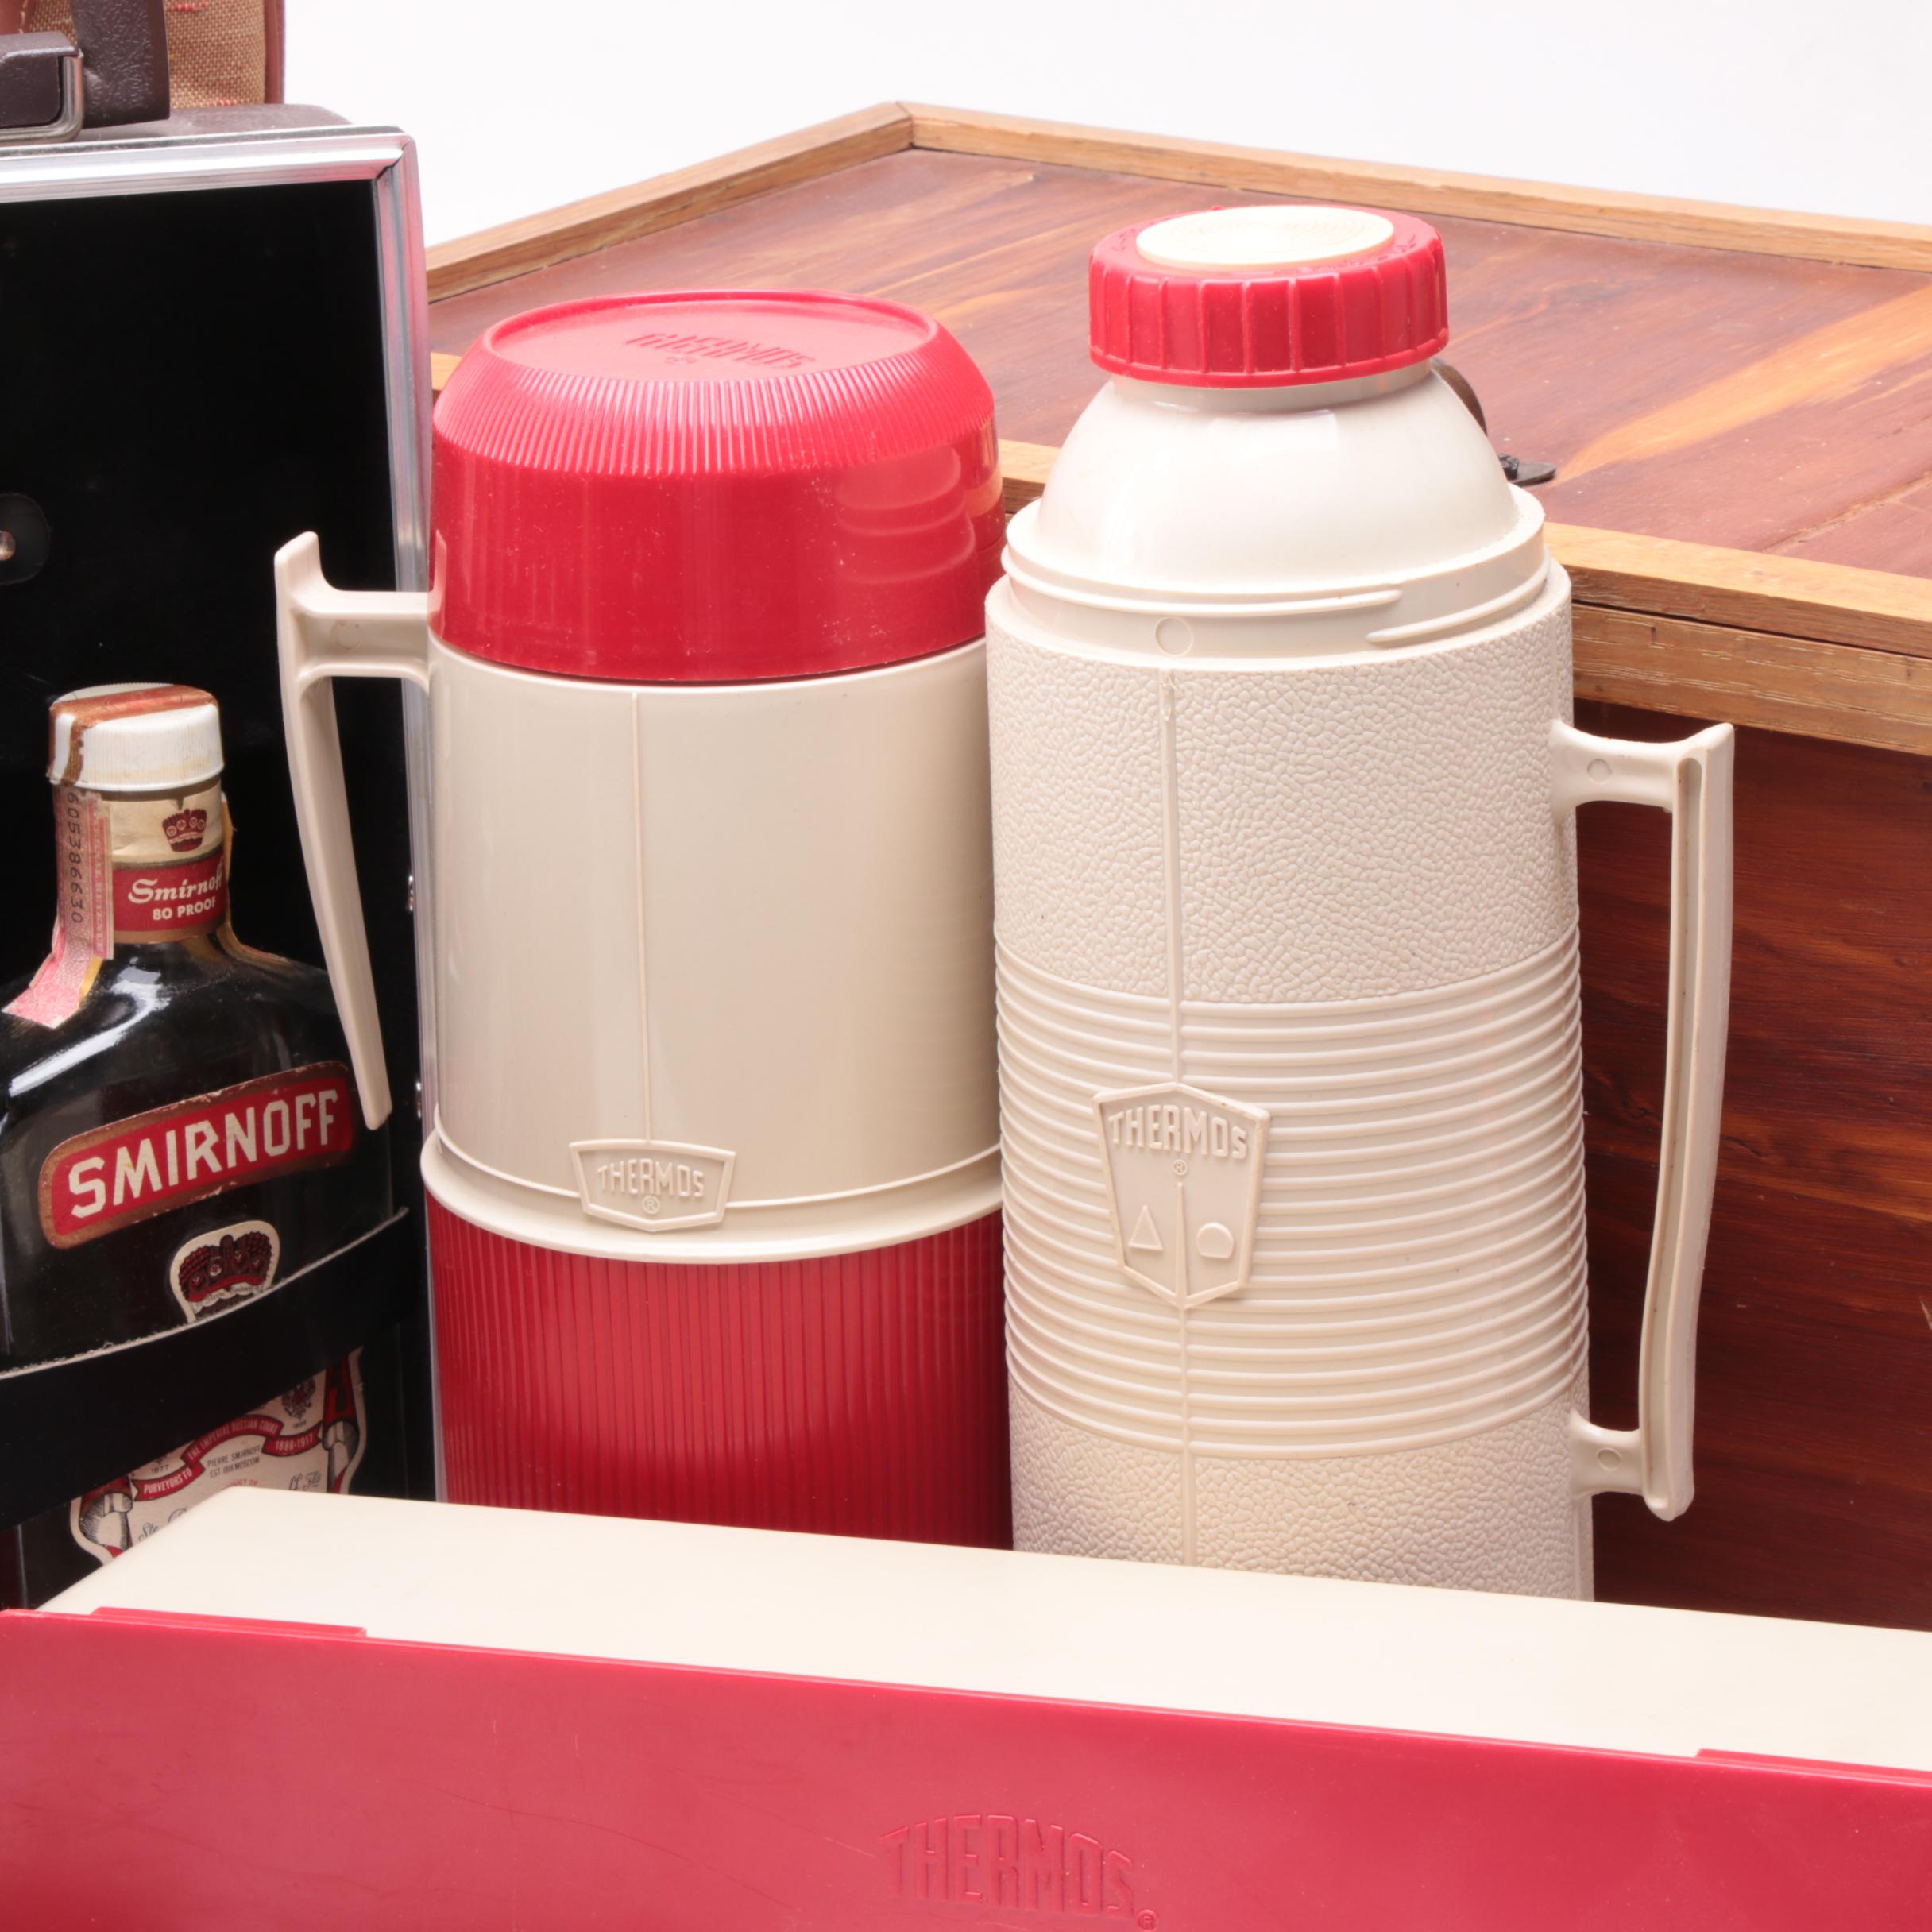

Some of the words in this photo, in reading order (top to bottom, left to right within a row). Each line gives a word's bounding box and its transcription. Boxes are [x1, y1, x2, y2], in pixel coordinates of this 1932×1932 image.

[153, 907, 172, 921] 80
[177, 895, 216, 918] PROOF
[68, 1089, 339, 1219] SMIRNOFF
[1107, 1104, 1248, 1160] THERMOS
[597, 1157, 705, 1197] THERMOS
[144, 1474, 184, 1494] PURVEYORS
[182, 1466, 193, 1480] TO
[879, 1814, 1135, 1919] THERMOS
